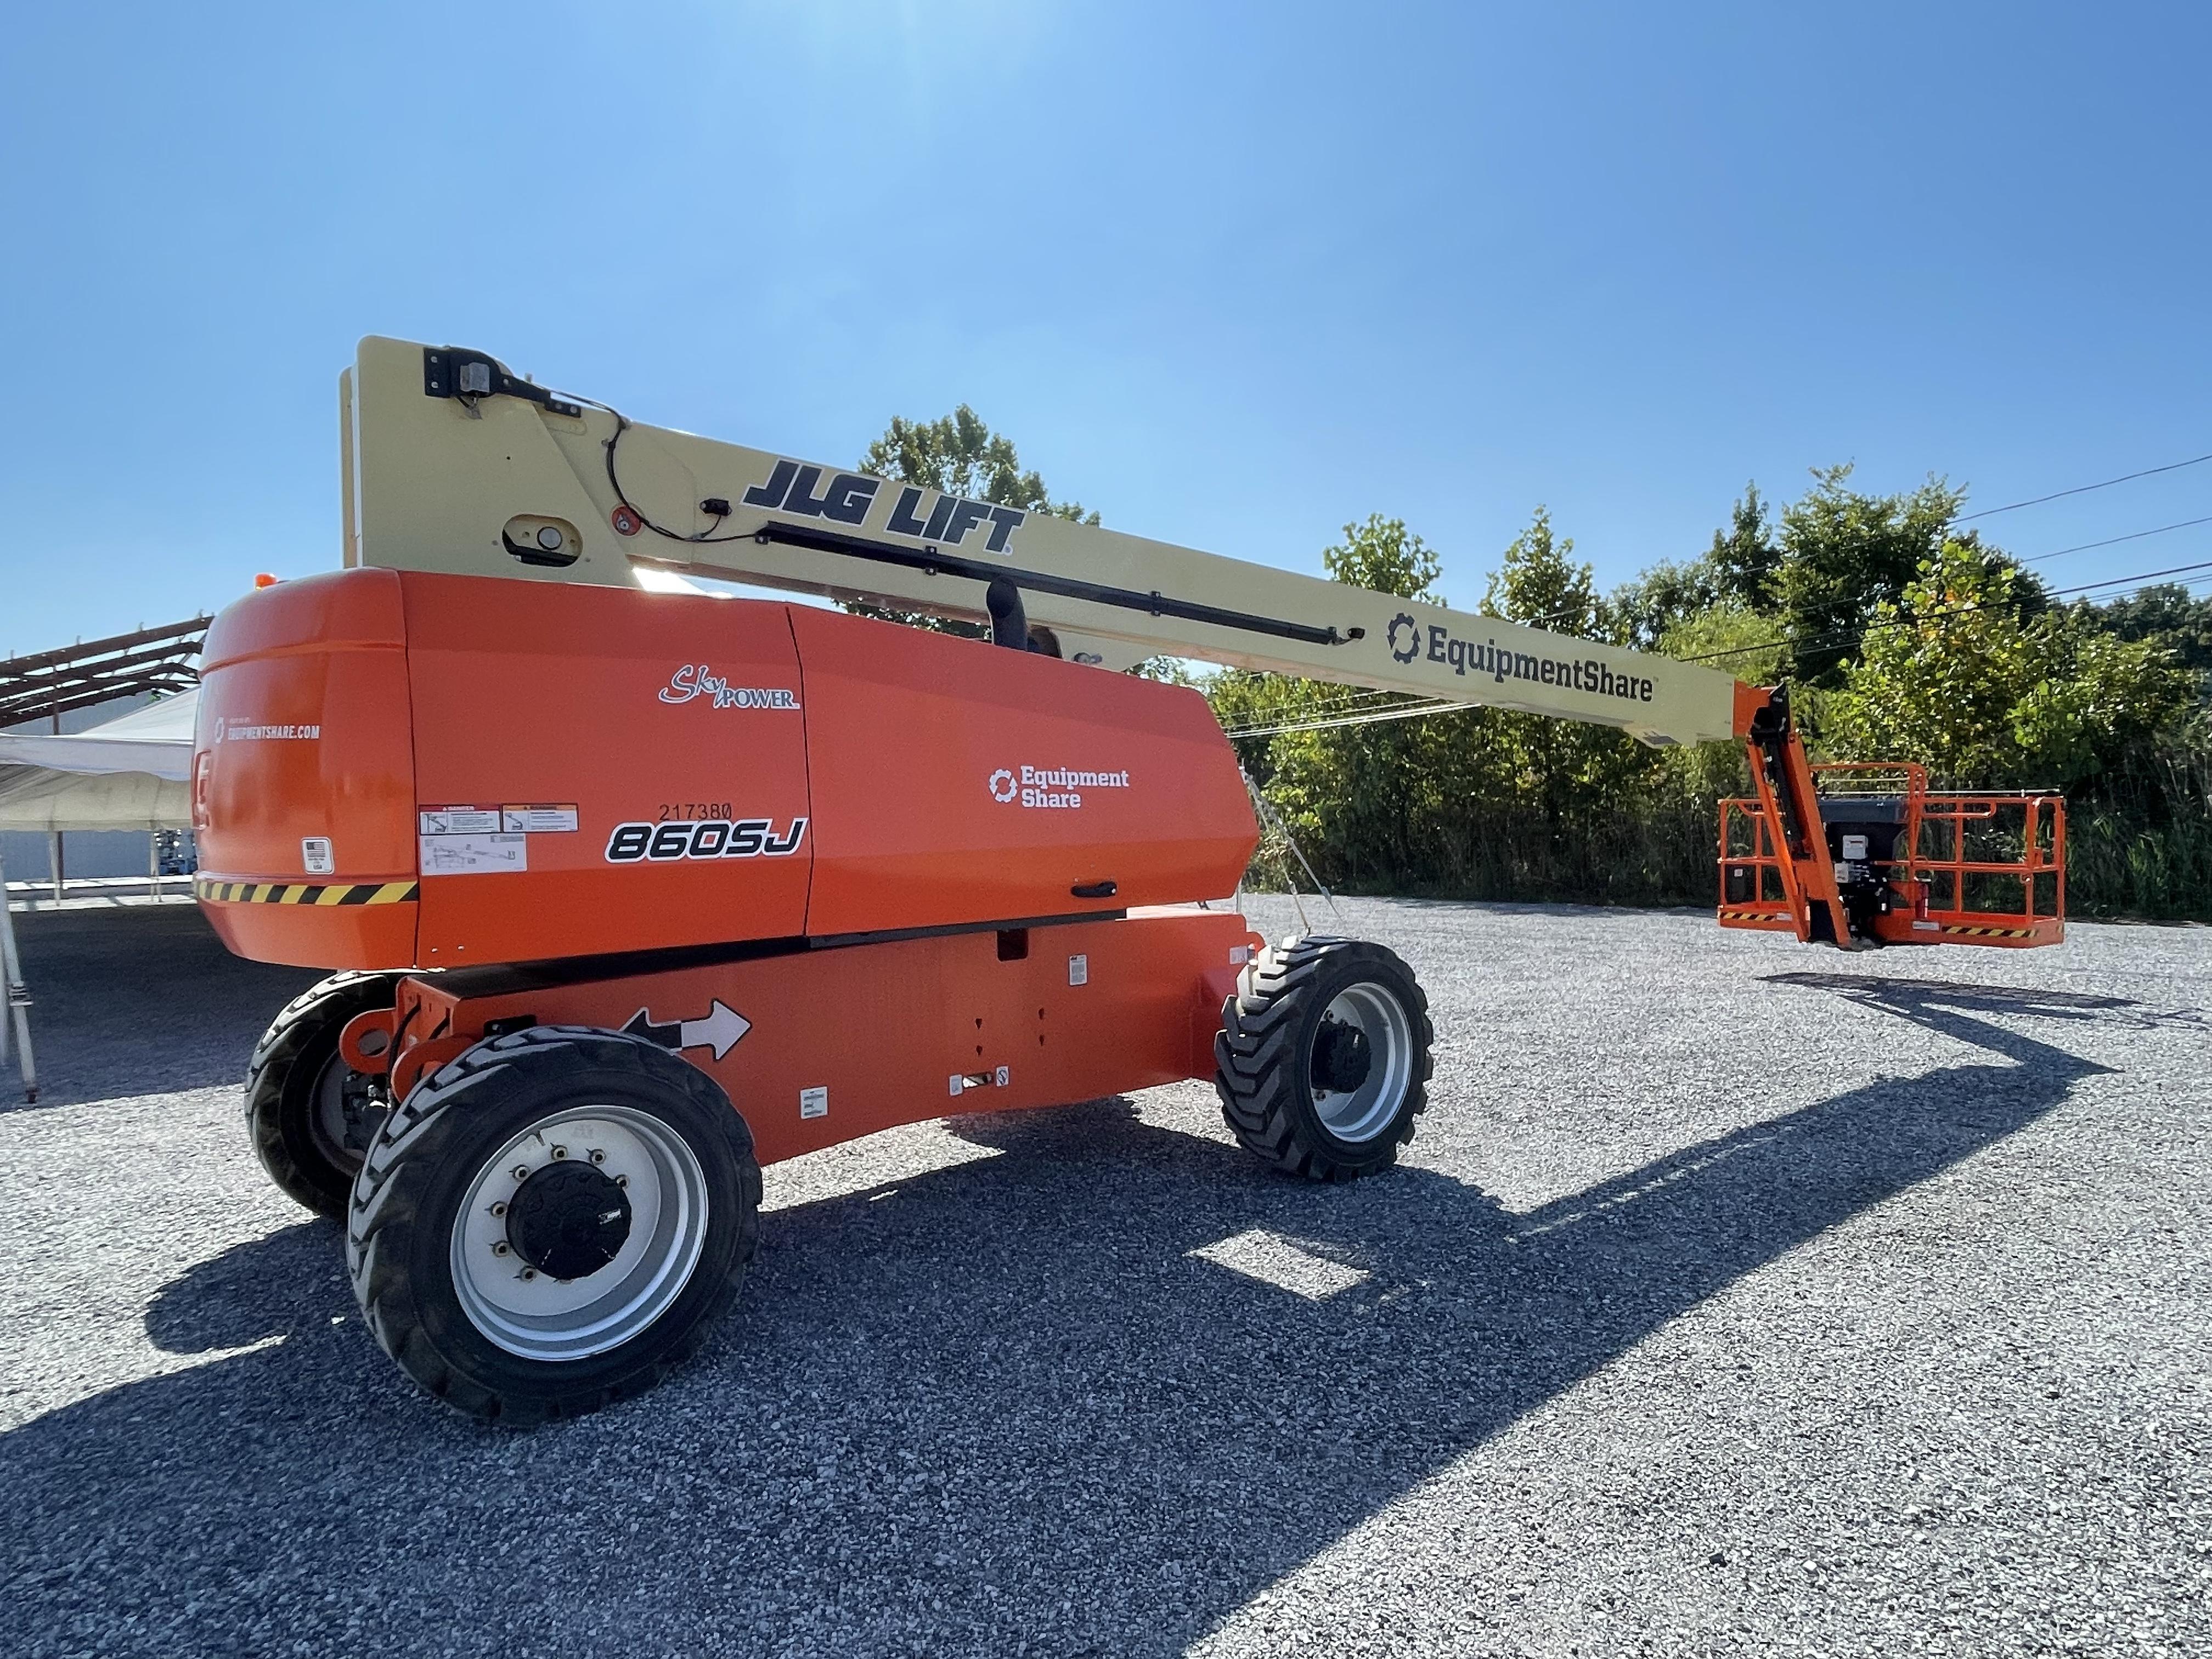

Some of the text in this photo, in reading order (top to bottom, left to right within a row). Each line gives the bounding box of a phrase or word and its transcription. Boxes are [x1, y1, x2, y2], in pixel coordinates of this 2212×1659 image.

[741, 460, 1027, 555] JLG LIFT
[1426, 624, 1653, 702] EquipmentShare
[658, 664, 799, 709] Sky POWER
[228, 725, 320, 740] EPMENTSHARE.COM
[1020, 766, 1129, 789] Equipment
[659, 803, 732, 820] 217380
[1022, 788, 1081, 808] Share
[605, 817, 809, 863] 860SJ
